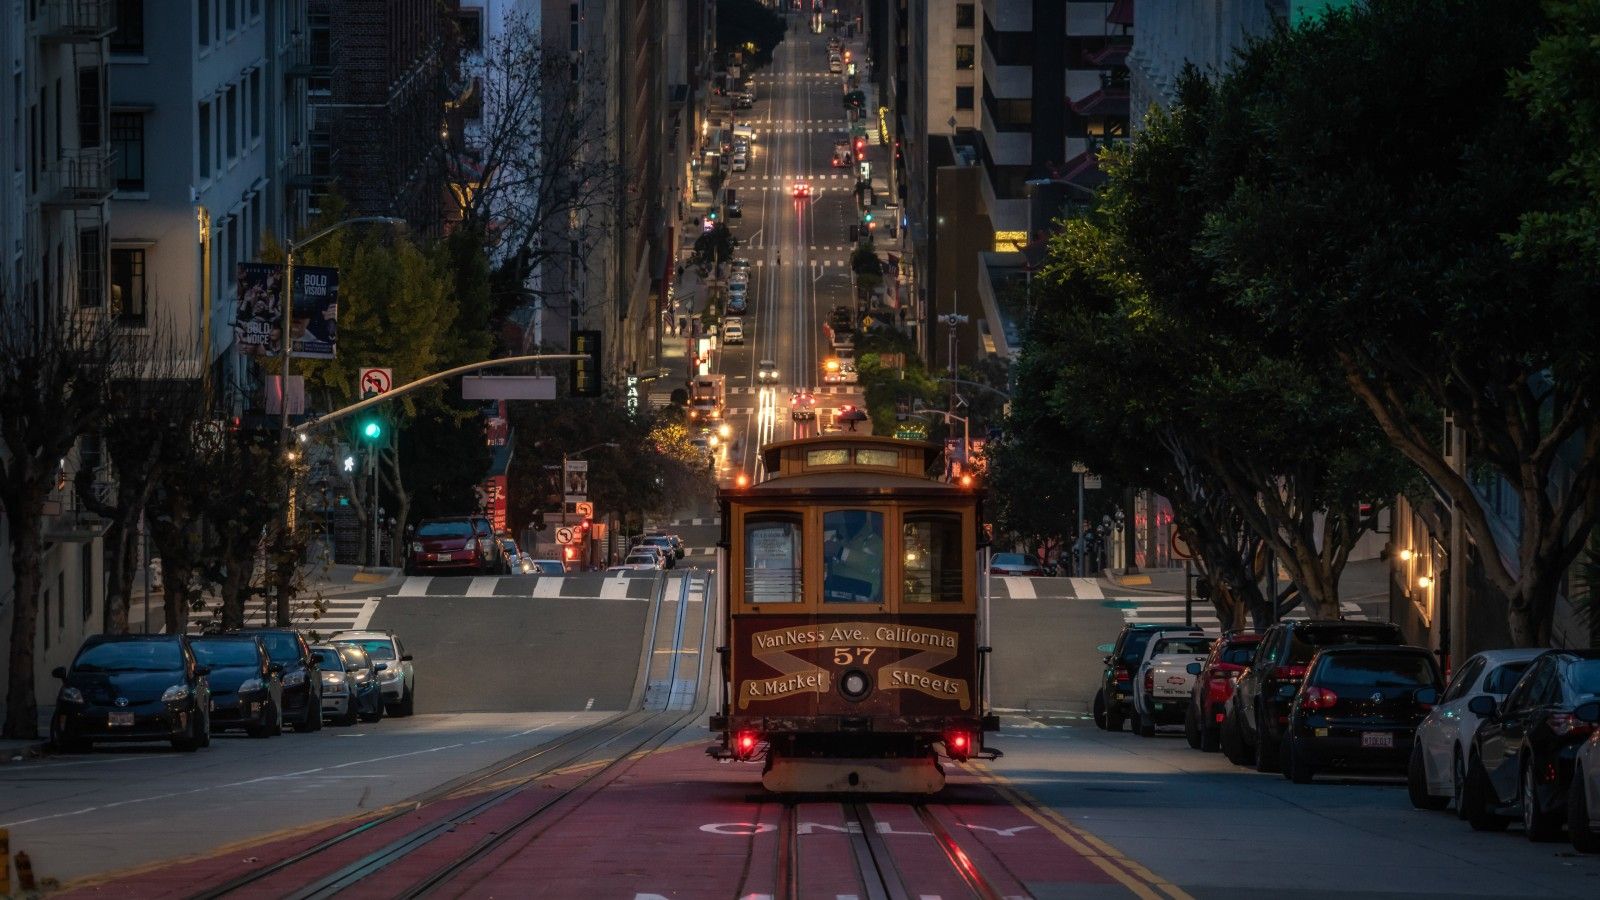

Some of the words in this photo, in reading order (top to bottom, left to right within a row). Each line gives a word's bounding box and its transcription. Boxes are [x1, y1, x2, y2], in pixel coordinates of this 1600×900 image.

[304, 274, 327, 287] BOLD
[304, 286, 327, 296] VISION
[247, 334, 269, 345] VOICE
[876, 627, 955, 647] California
[833, 647, 876, 666] 57
[749, 681, 760, 696] &
[764, 672, 822, 696] Market
[891, 670, 959, 694] Streets
[699, 822, 1038, 837] ONLY
